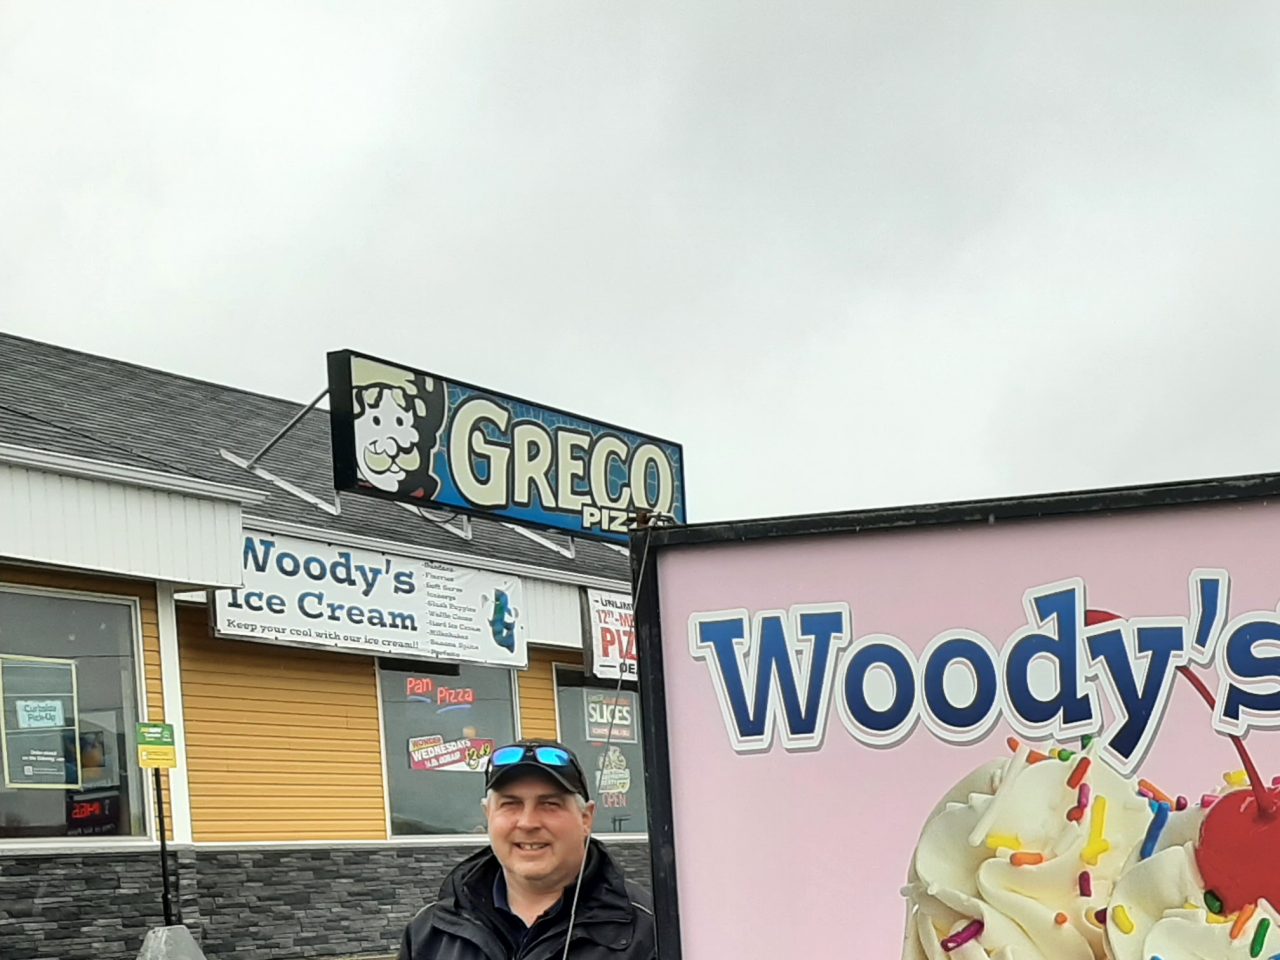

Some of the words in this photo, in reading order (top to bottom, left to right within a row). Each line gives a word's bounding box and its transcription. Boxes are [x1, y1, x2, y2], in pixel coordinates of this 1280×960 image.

[450, 399, 674, 515] GRECO
[582, 505, 640, 532] PIZ
[228, 588, 286, 614] Ice
[297, 591, 418, 631] Cream
[600, 596, 634, 611] UNLIM
[226, 618, 257, 632] Keep
[259, 624, 286, 634] your
[289, 624, 312, 637] cool
[315, 630, 341, 641] with
[343, 634, 361, 643] our
[364, 634, 379, 646] ice
[600, 626, 638, 661] PIZ
[619, 662, 638, 675] DE
[406, 677, 432, 696] Pan
[437, 686, 473, 705] Pizza
[588, 703, 631, 725] SLICES
[411, 739, 471, 762] WEDNESDAYS
[602, 792, 626, 807] OPEN
